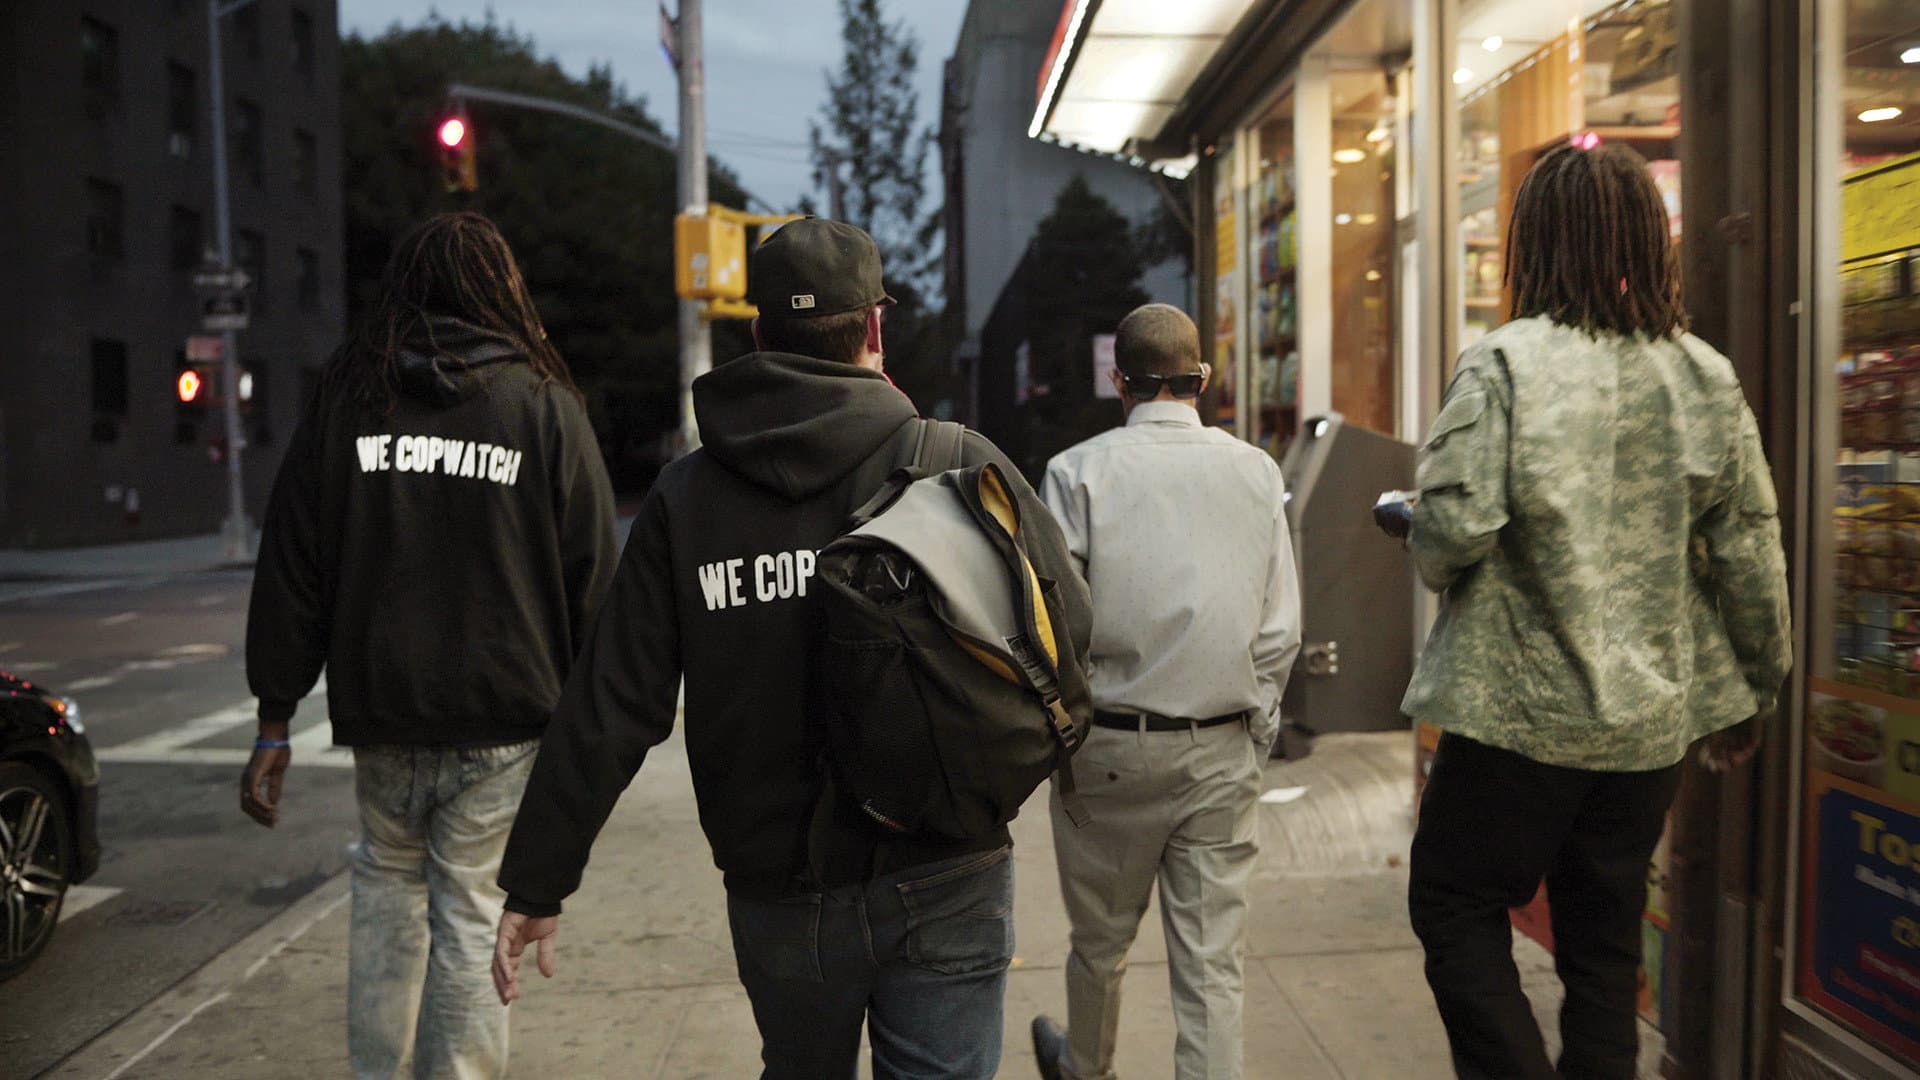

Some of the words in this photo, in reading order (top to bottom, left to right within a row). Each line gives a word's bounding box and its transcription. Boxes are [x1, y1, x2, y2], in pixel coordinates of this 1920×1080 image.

[355, 434, 392, 473] WE
[395, 434, 522, 486] COPWATCH
[698, 557, 747, 611] WE
[754, 549, 822, 603] COP
